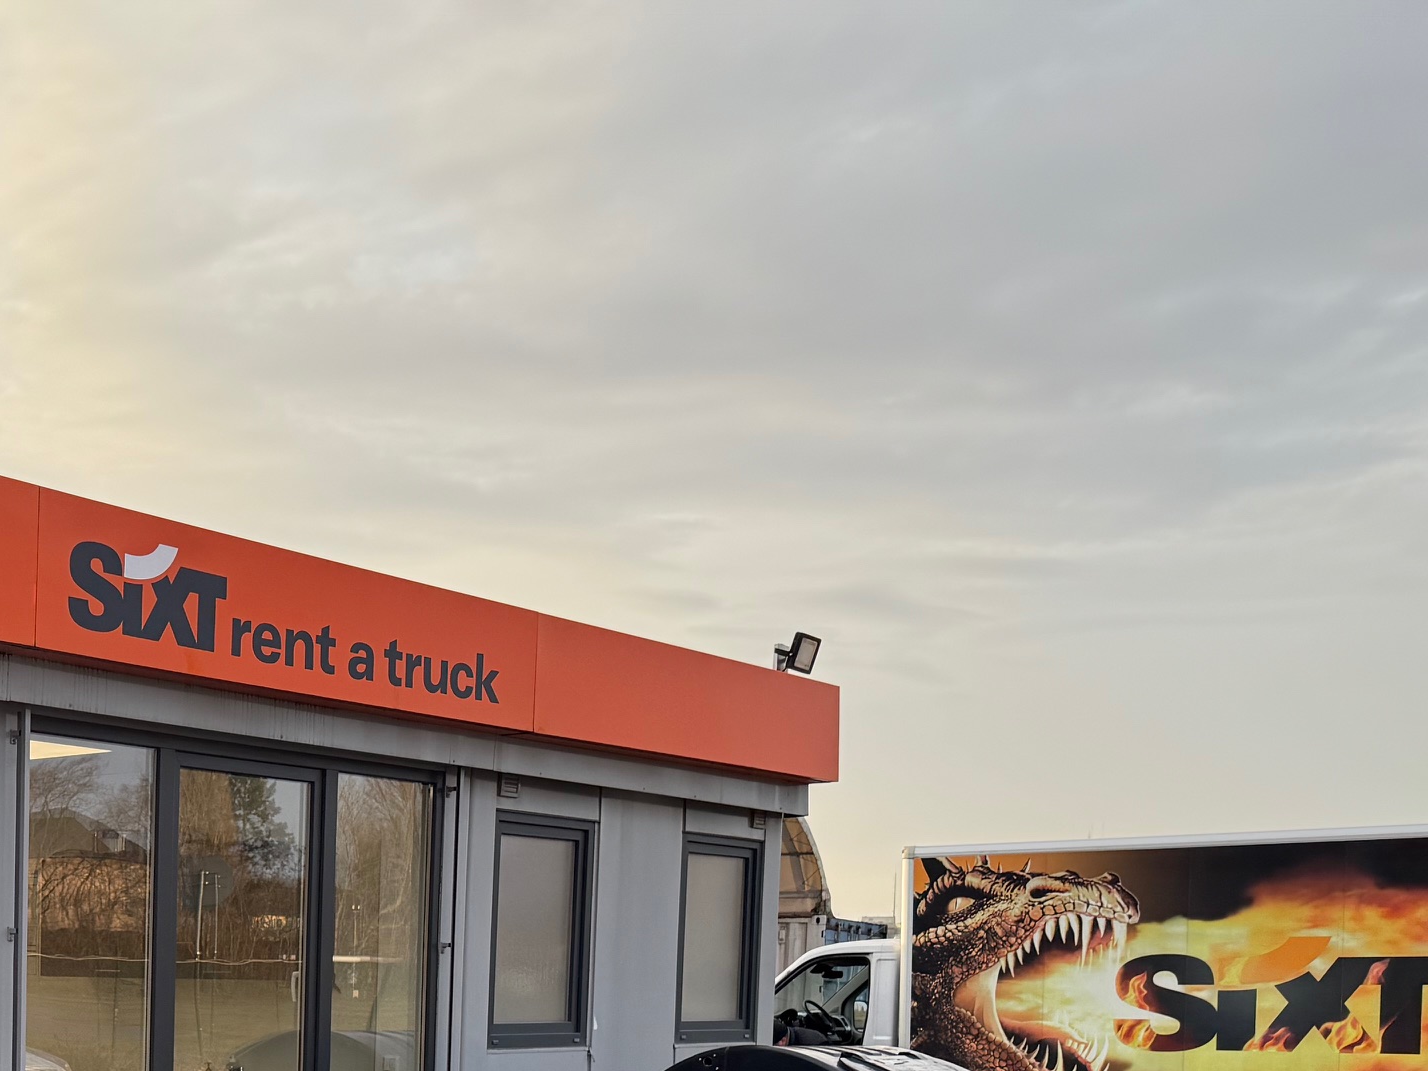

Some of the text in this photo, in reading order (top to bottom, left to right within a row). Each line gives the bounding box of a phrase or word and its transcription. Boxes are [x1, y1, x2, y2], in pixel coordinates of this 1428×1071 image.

[67, 541, 500, 704] SIXT rent a truck
[1113, 936, 1428, 1055] SIXT
